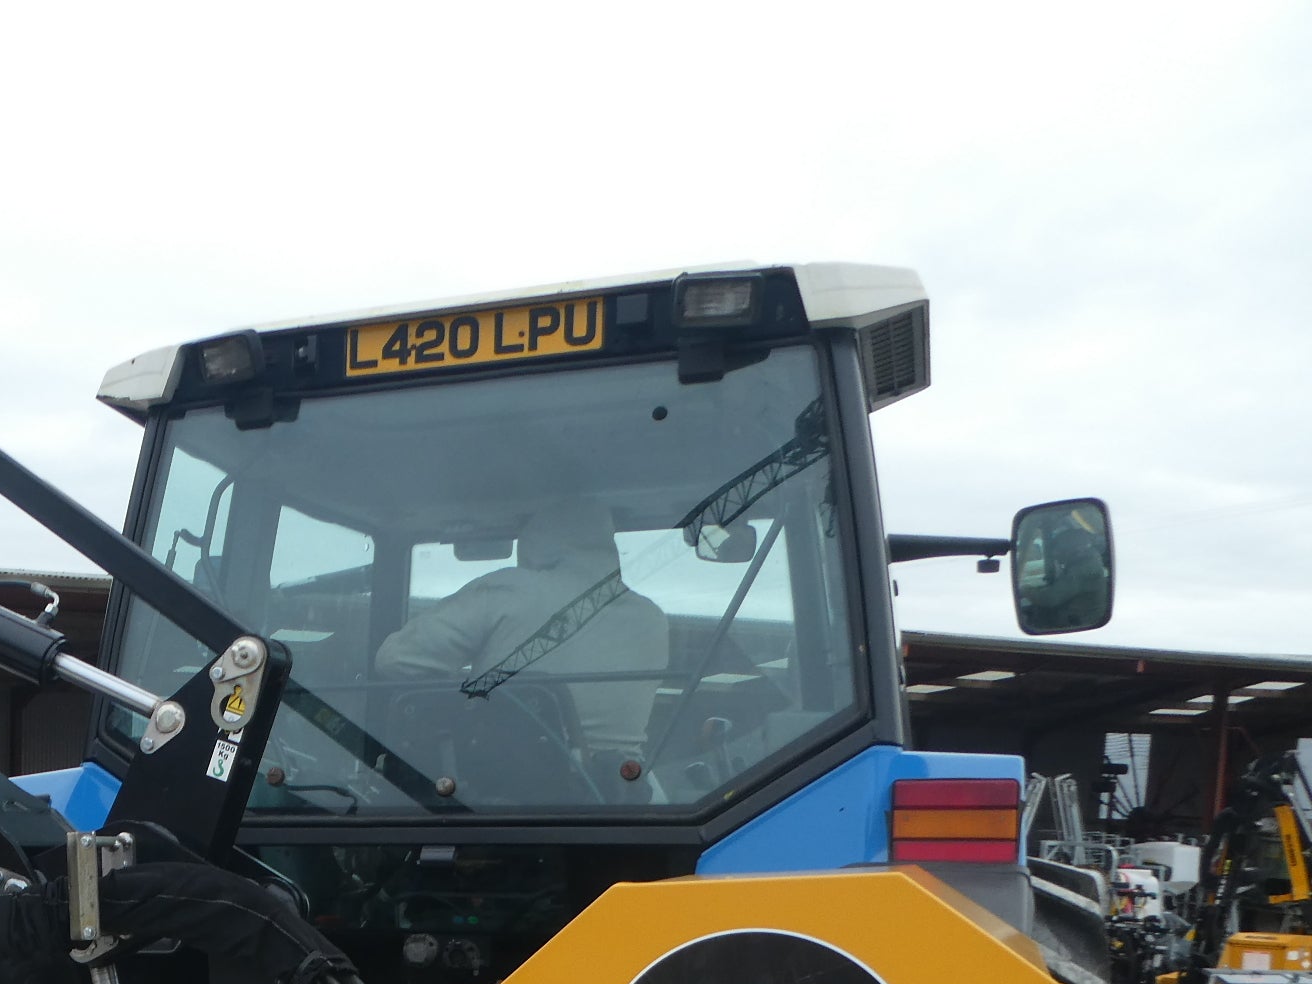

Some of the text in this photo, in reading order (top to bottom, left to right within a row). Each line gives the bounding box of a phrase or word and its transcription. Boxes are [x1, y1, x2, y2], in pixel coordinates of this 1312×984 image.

[349, 301, 598, 370] L420 LPU
[218, 742, 236, 753] 1500
